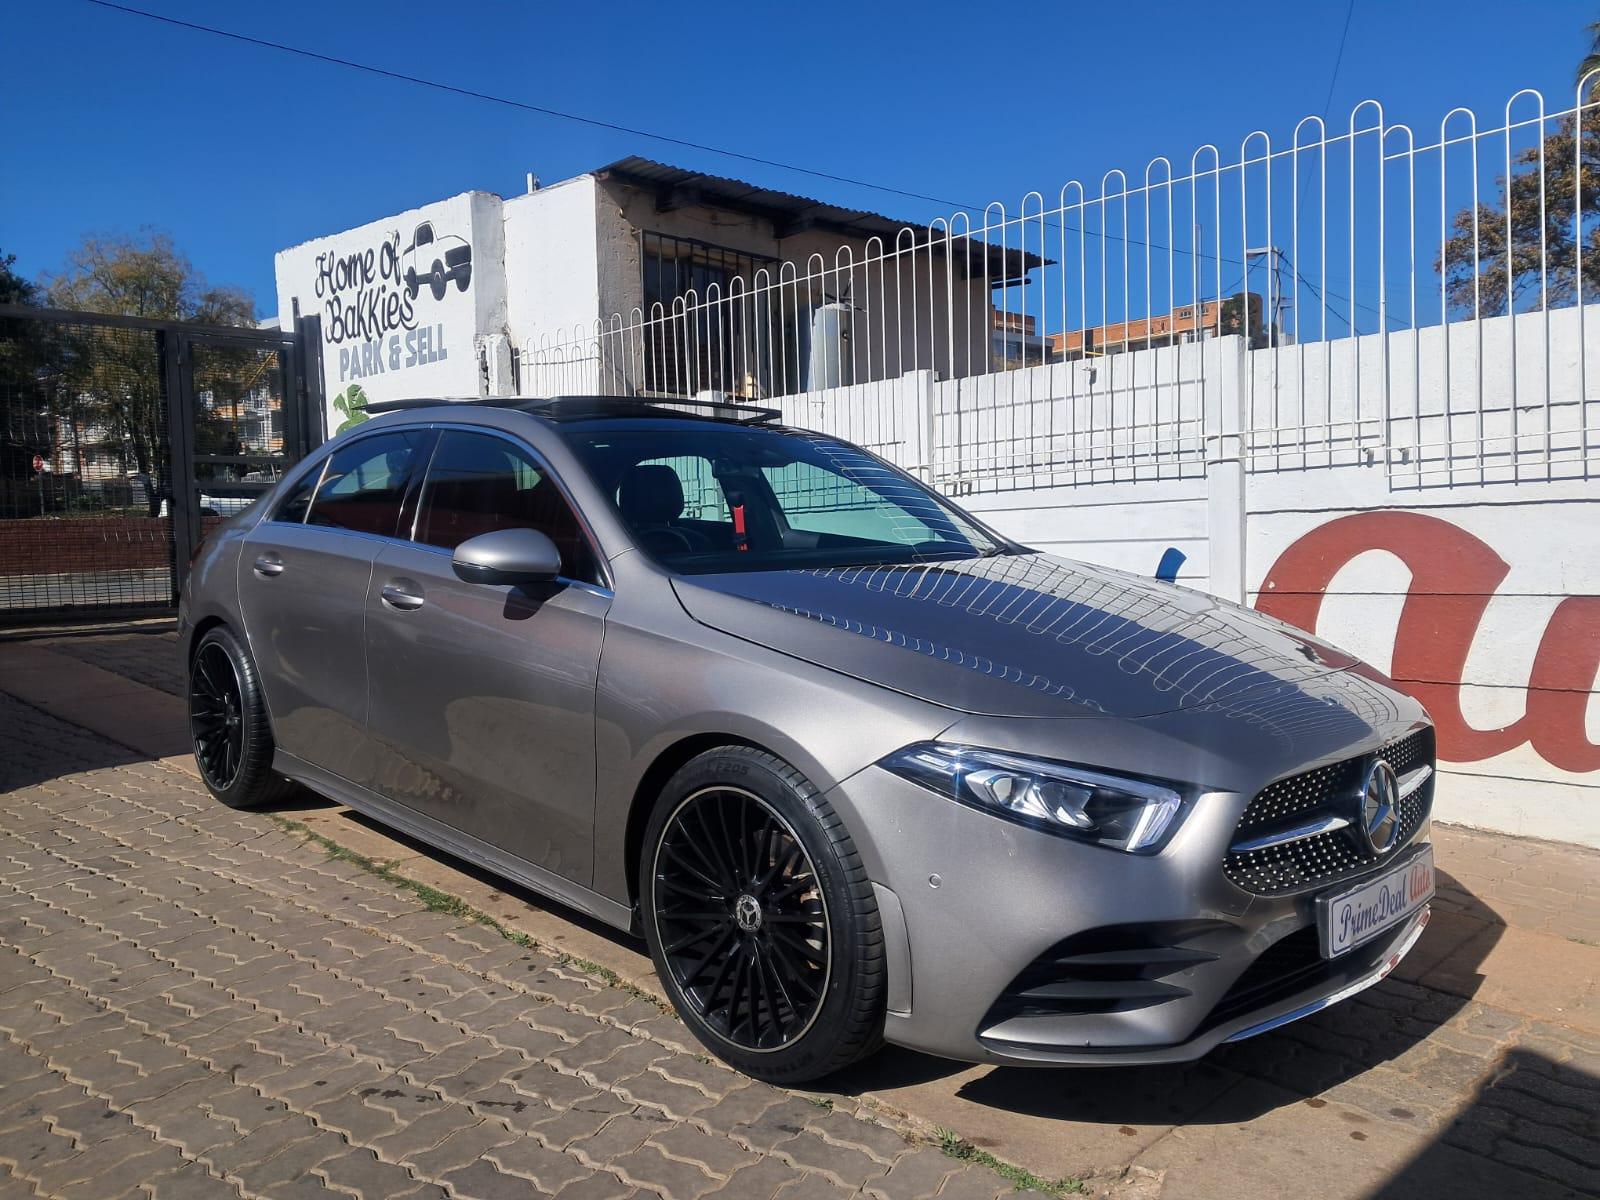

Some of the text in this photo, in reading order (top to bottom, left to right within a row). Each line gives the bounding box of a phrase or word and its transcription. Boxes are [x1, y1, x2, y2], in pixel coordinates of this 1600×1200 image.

[315, 248, 376, 299] Home
[340, 323, 448, 383] PARK & SELL
